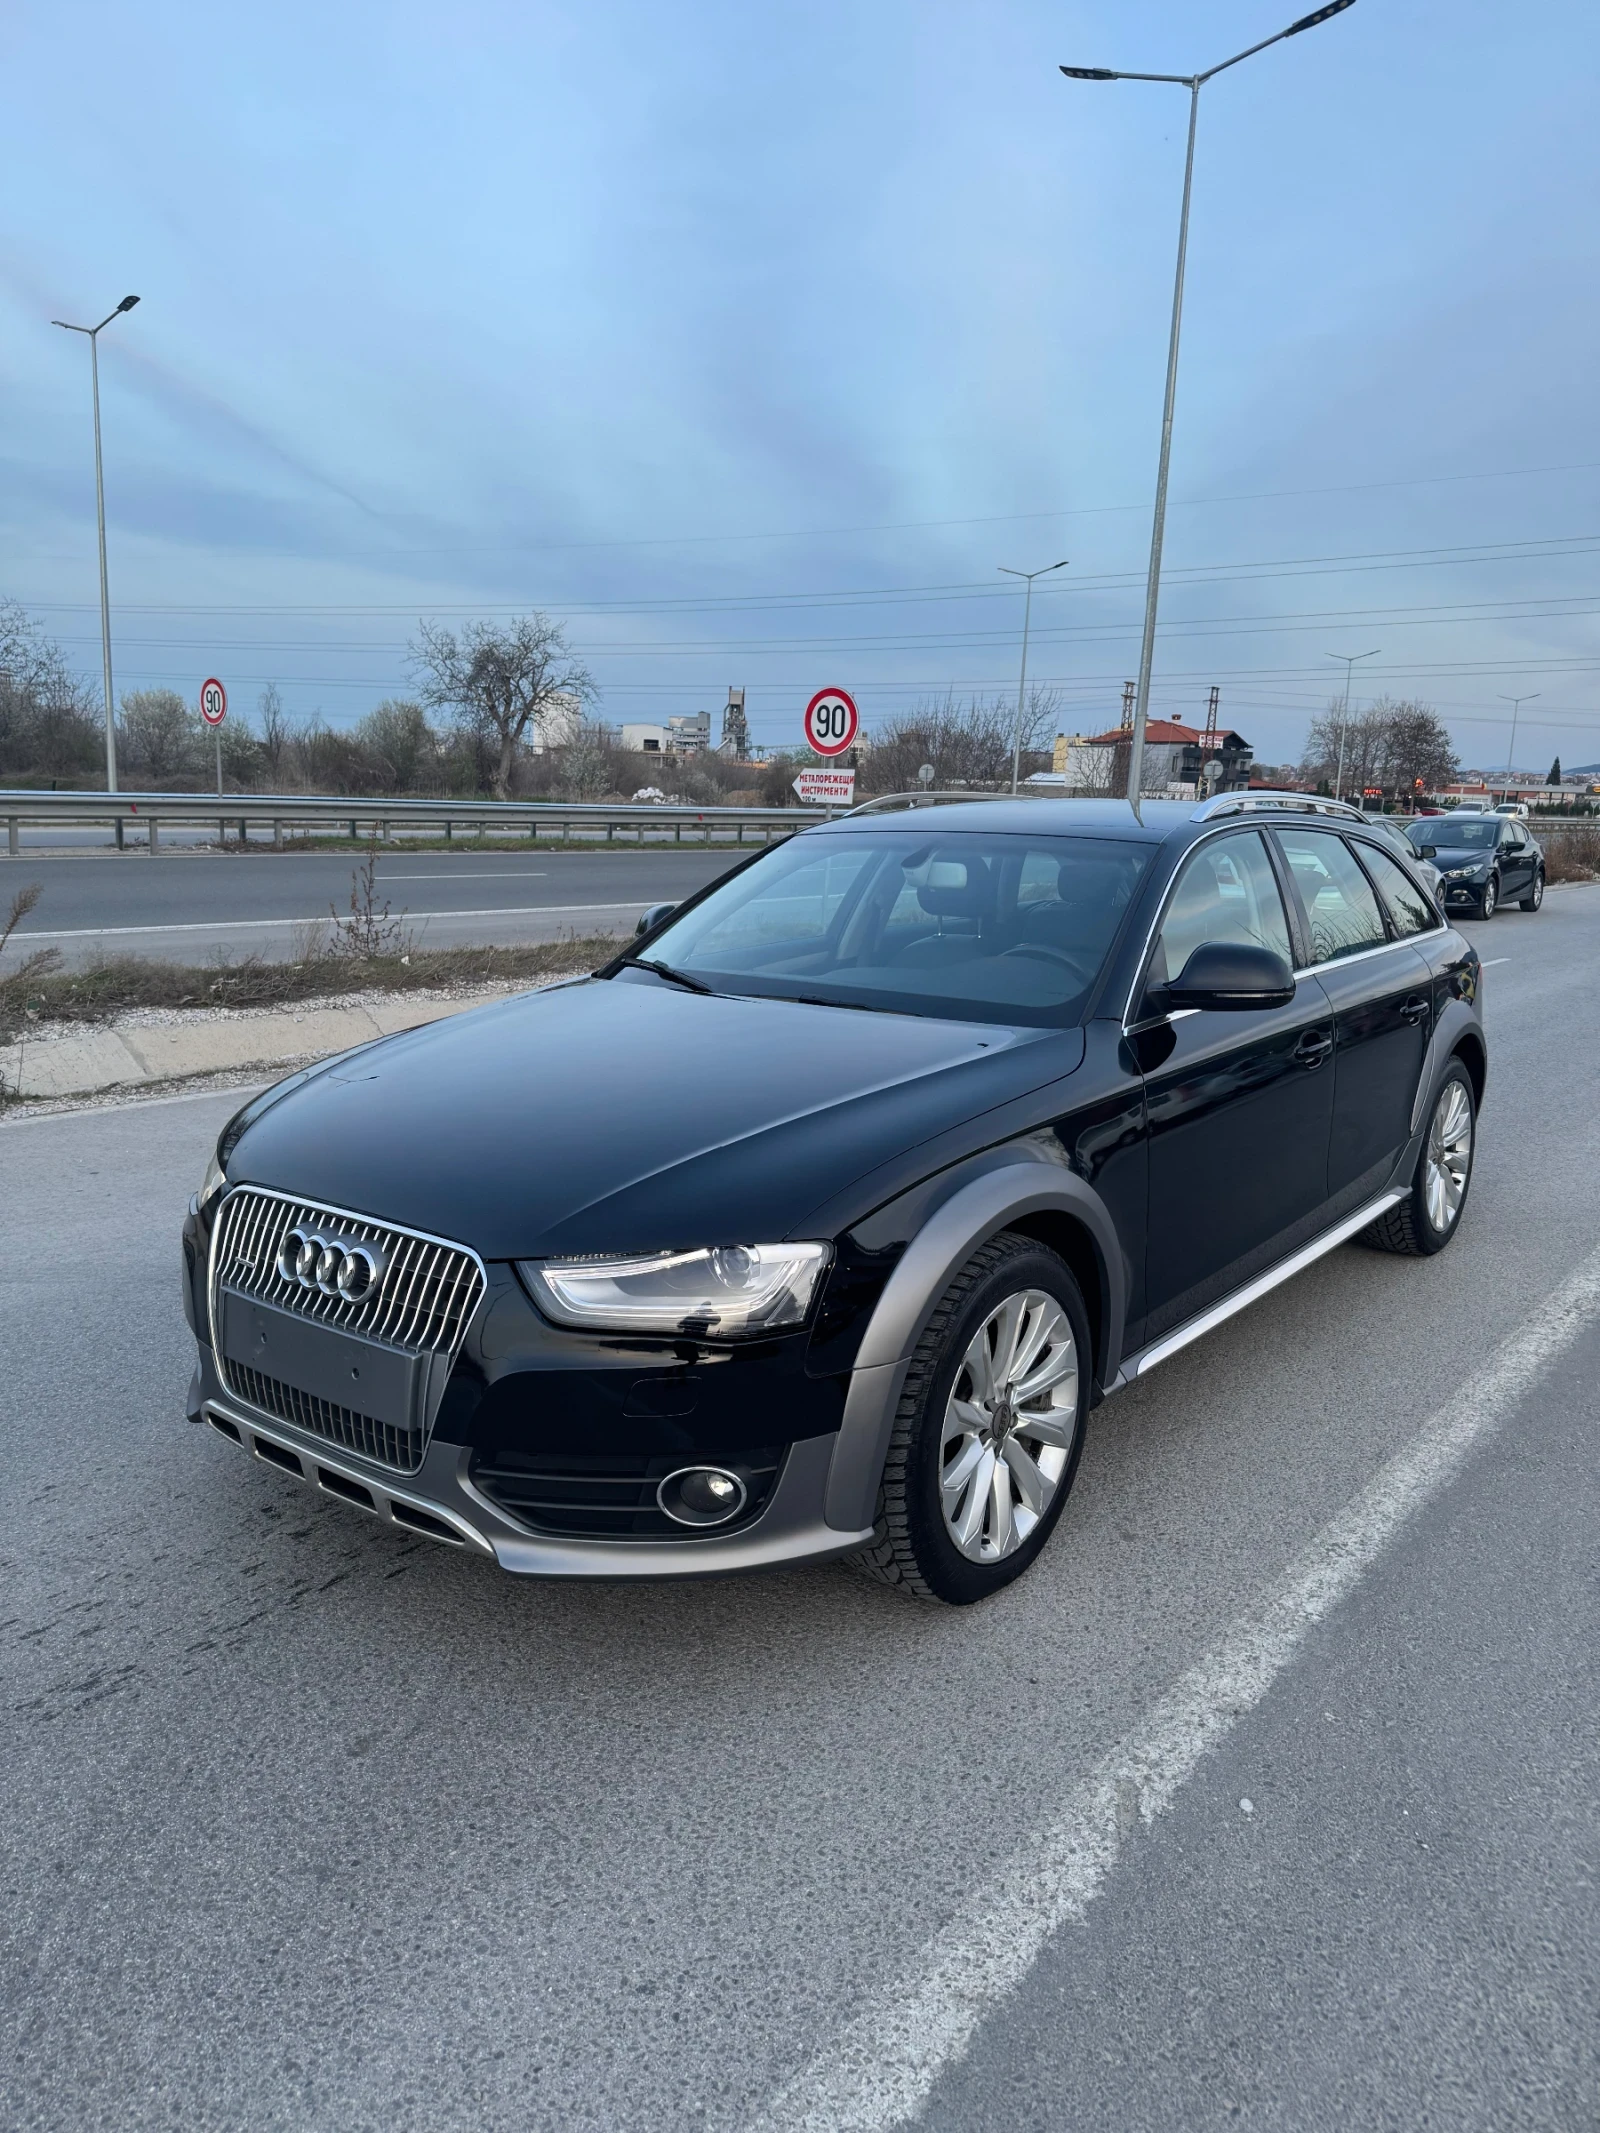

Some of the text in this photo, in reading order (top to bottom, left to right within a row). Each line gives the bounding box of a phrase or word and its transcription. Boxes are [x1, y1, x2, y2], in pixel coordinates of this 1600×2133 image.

[206, 690, 220, 713] 90
[816, 704, 845, 738] 90
[799, 774, 855, 785] МЕТАЛОРЕЖЕЩИ
[801, 786, 848, 796] ИНСТРУМЕНТИ
